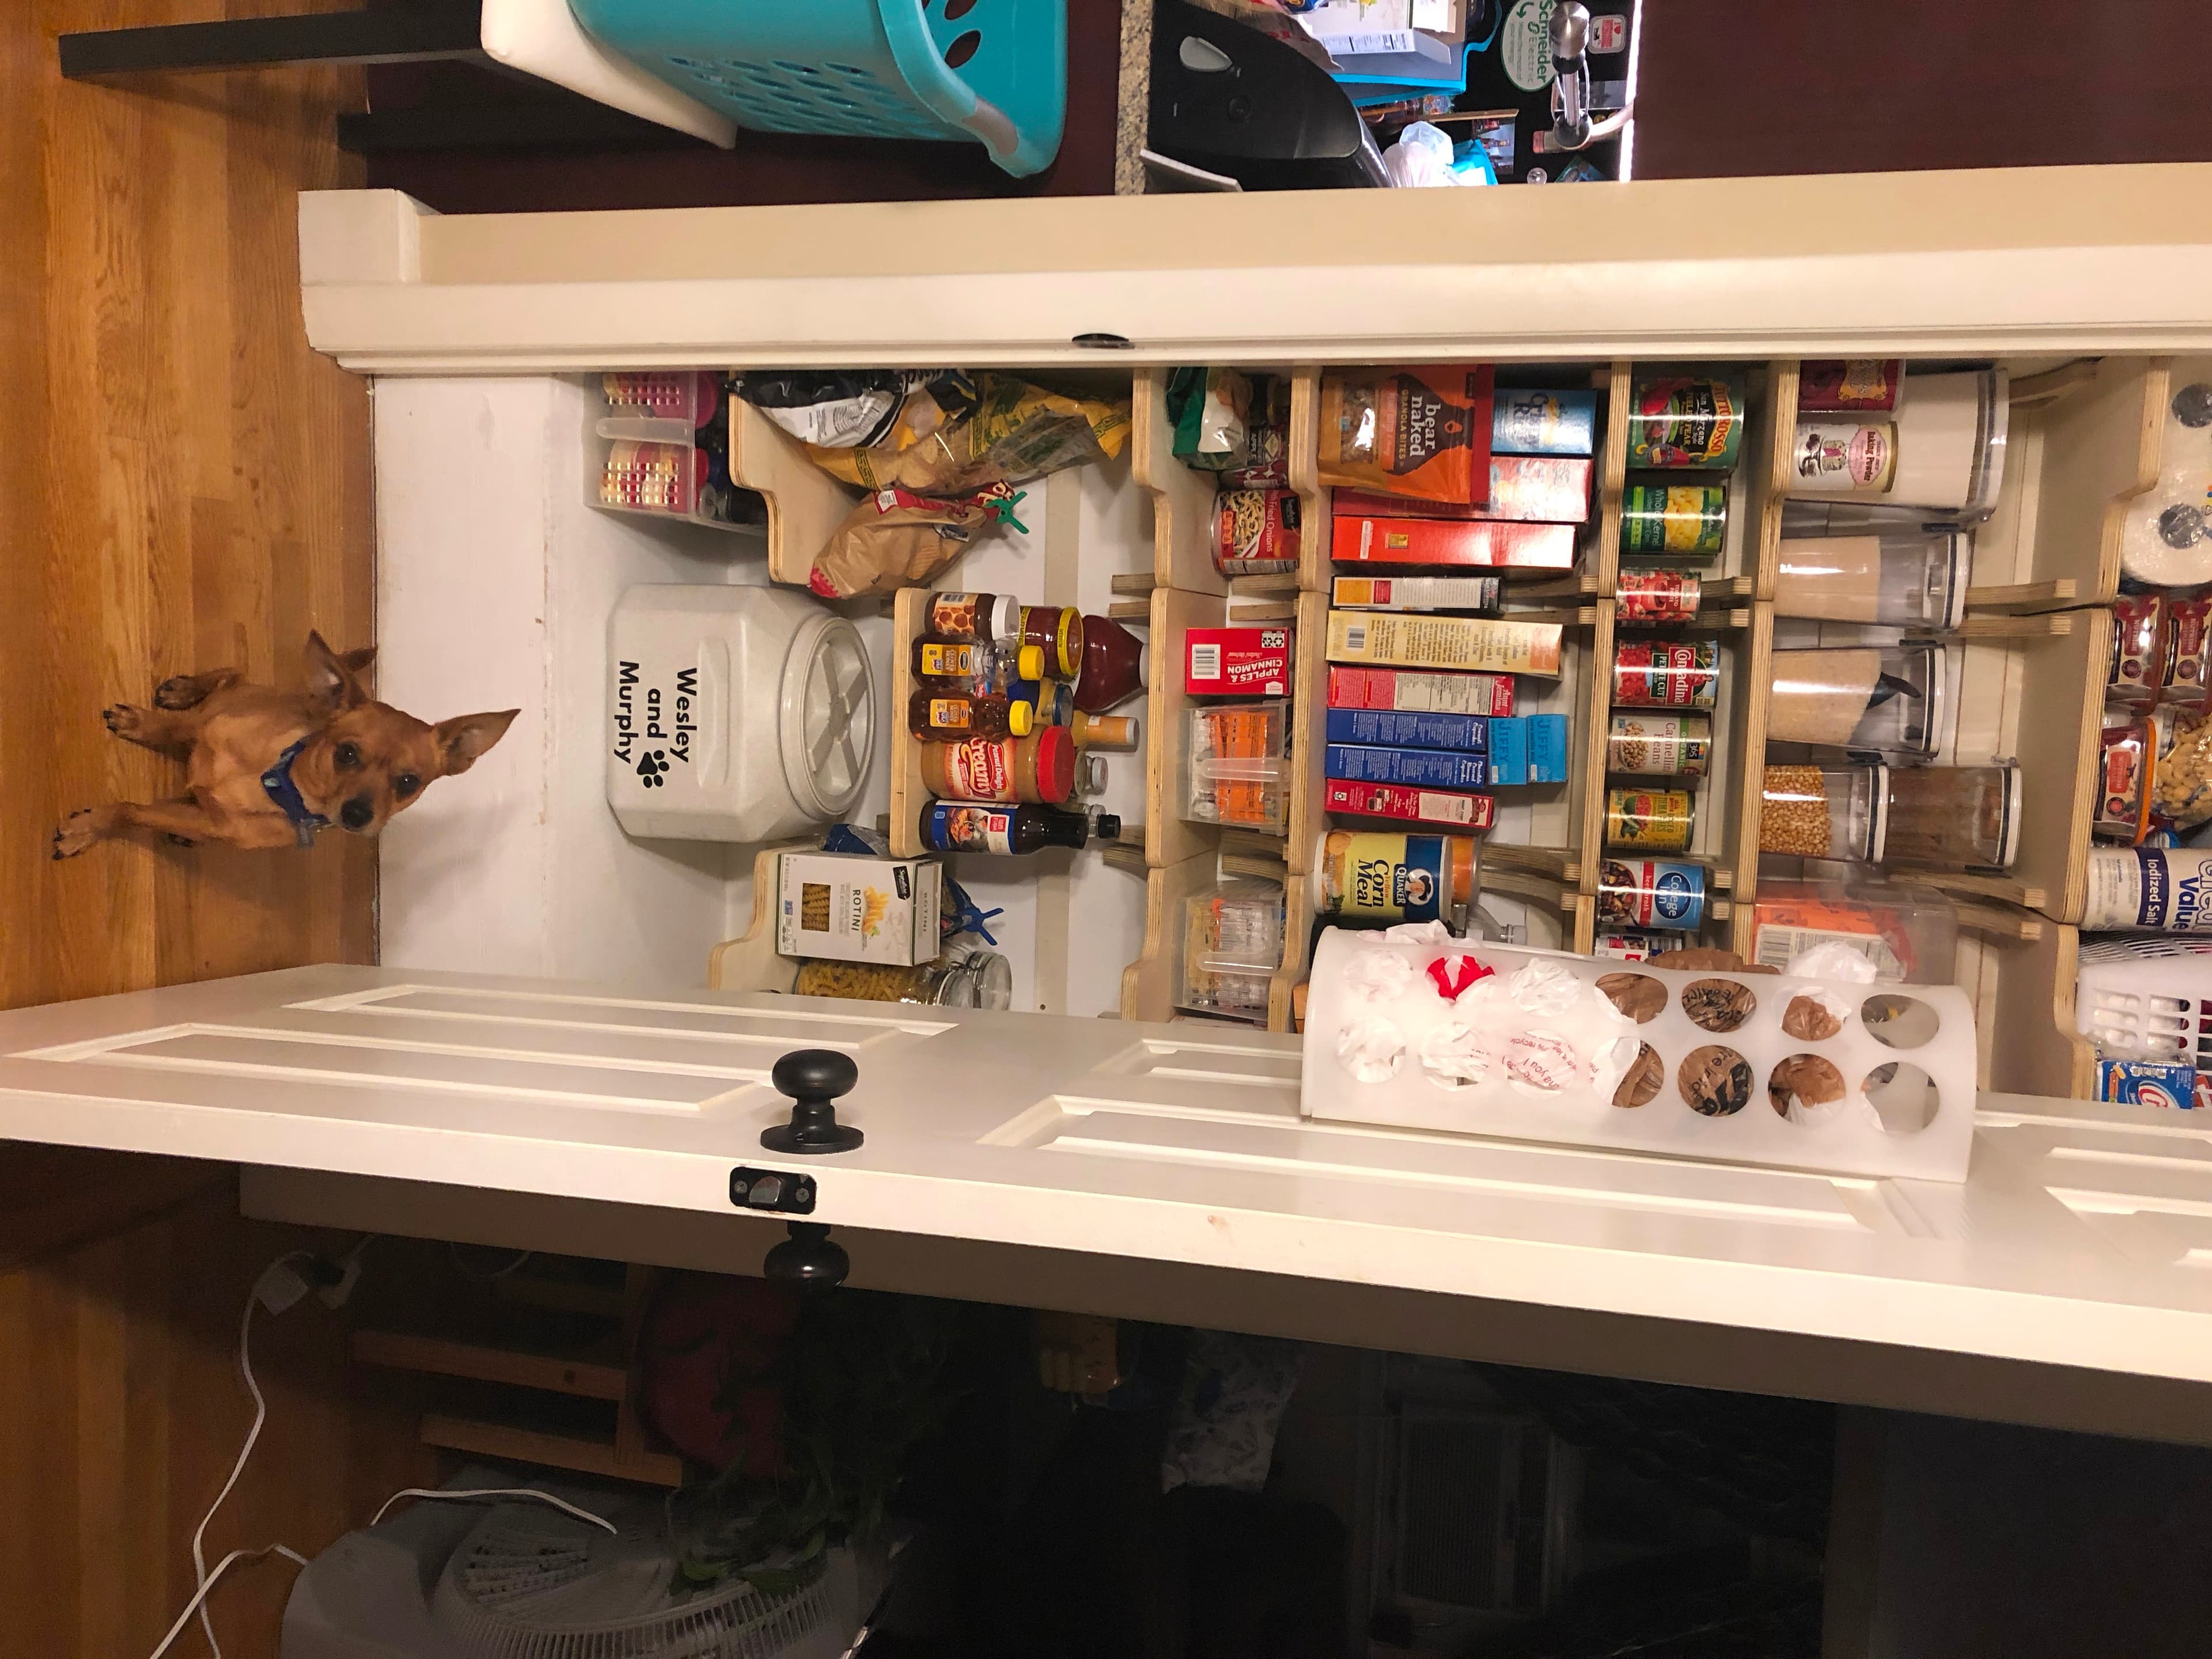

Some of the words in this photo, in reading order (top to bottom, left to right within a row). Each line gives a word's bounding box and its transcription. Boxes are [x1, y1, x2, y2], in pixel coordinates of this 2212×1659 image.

[1537, 0, 1551, 84] Schneider
[1527, 36, 1537, 84] Electric
[1700, 392, 1709, 405] San
[1410, 396, 1425, 457] naked
[1425, 403, 1441, 449] bear
[1683, 423, 1692, 446] PEAR
[1697, 407, 1710, 446] Mrzano
[1249, 433, 1257, 461] APPLE
[1398, 434, 1407, 460] BITES
[1865, 431, 1876, 455] Baking
[1864, 456, 1874, 482] Powder
[1267, 501, 1277, 521] Fried
[1654, 490, 1665, 516] Whole
[1266, 521, 1275, 552] Onions
[1652, 519, 1664, 546] Kernel
[1227, 659, 1283, 674] CINNAMON
[1230, 674, 1238, 683] &
[1240, 668, 1279, 682] APPLES
[1658, 656, 1668, 681] PETTE
[1673, 649, 1692, 703] Conadina
[1495, 680, 1505, 710] Jemima
[1502, 689, 1511, 707] Aunt
[1657, 682, 1665, 696] CUT
[613, 661, 639, 764] Murphy
[647, 688, 668, 739] and
[669, 667, 698, 763] Wesley
[1498, 721, 1512, 763] JIFFY
[1536, 720, 1551, 760] JIFFY
[1689, 744, 1698, 757] 365
[969, 737, 991, 796] Creamy
[991, 744, 1002, 767] Peanut
[995, 767, 1004, 790] Delight
[1657, 797, 1668, 832] TOMAES
[1667, 813, 1675, 833] DCED
[1357, 859, 1373, 908] Meal
[1372, 859, 1390, 907] Corn
[1395, 866, 1407, 904] QUAKER
[1658, 885, 1671, 904] In
[2147, 858, 2162, 902] Iodized
[851, 889, 862, 931] ROTINI
[1666, 875, 1682, 917] Colege
[2172, 877, 2199, 929] Value
[2145, 904, 2160, 924] Salt
